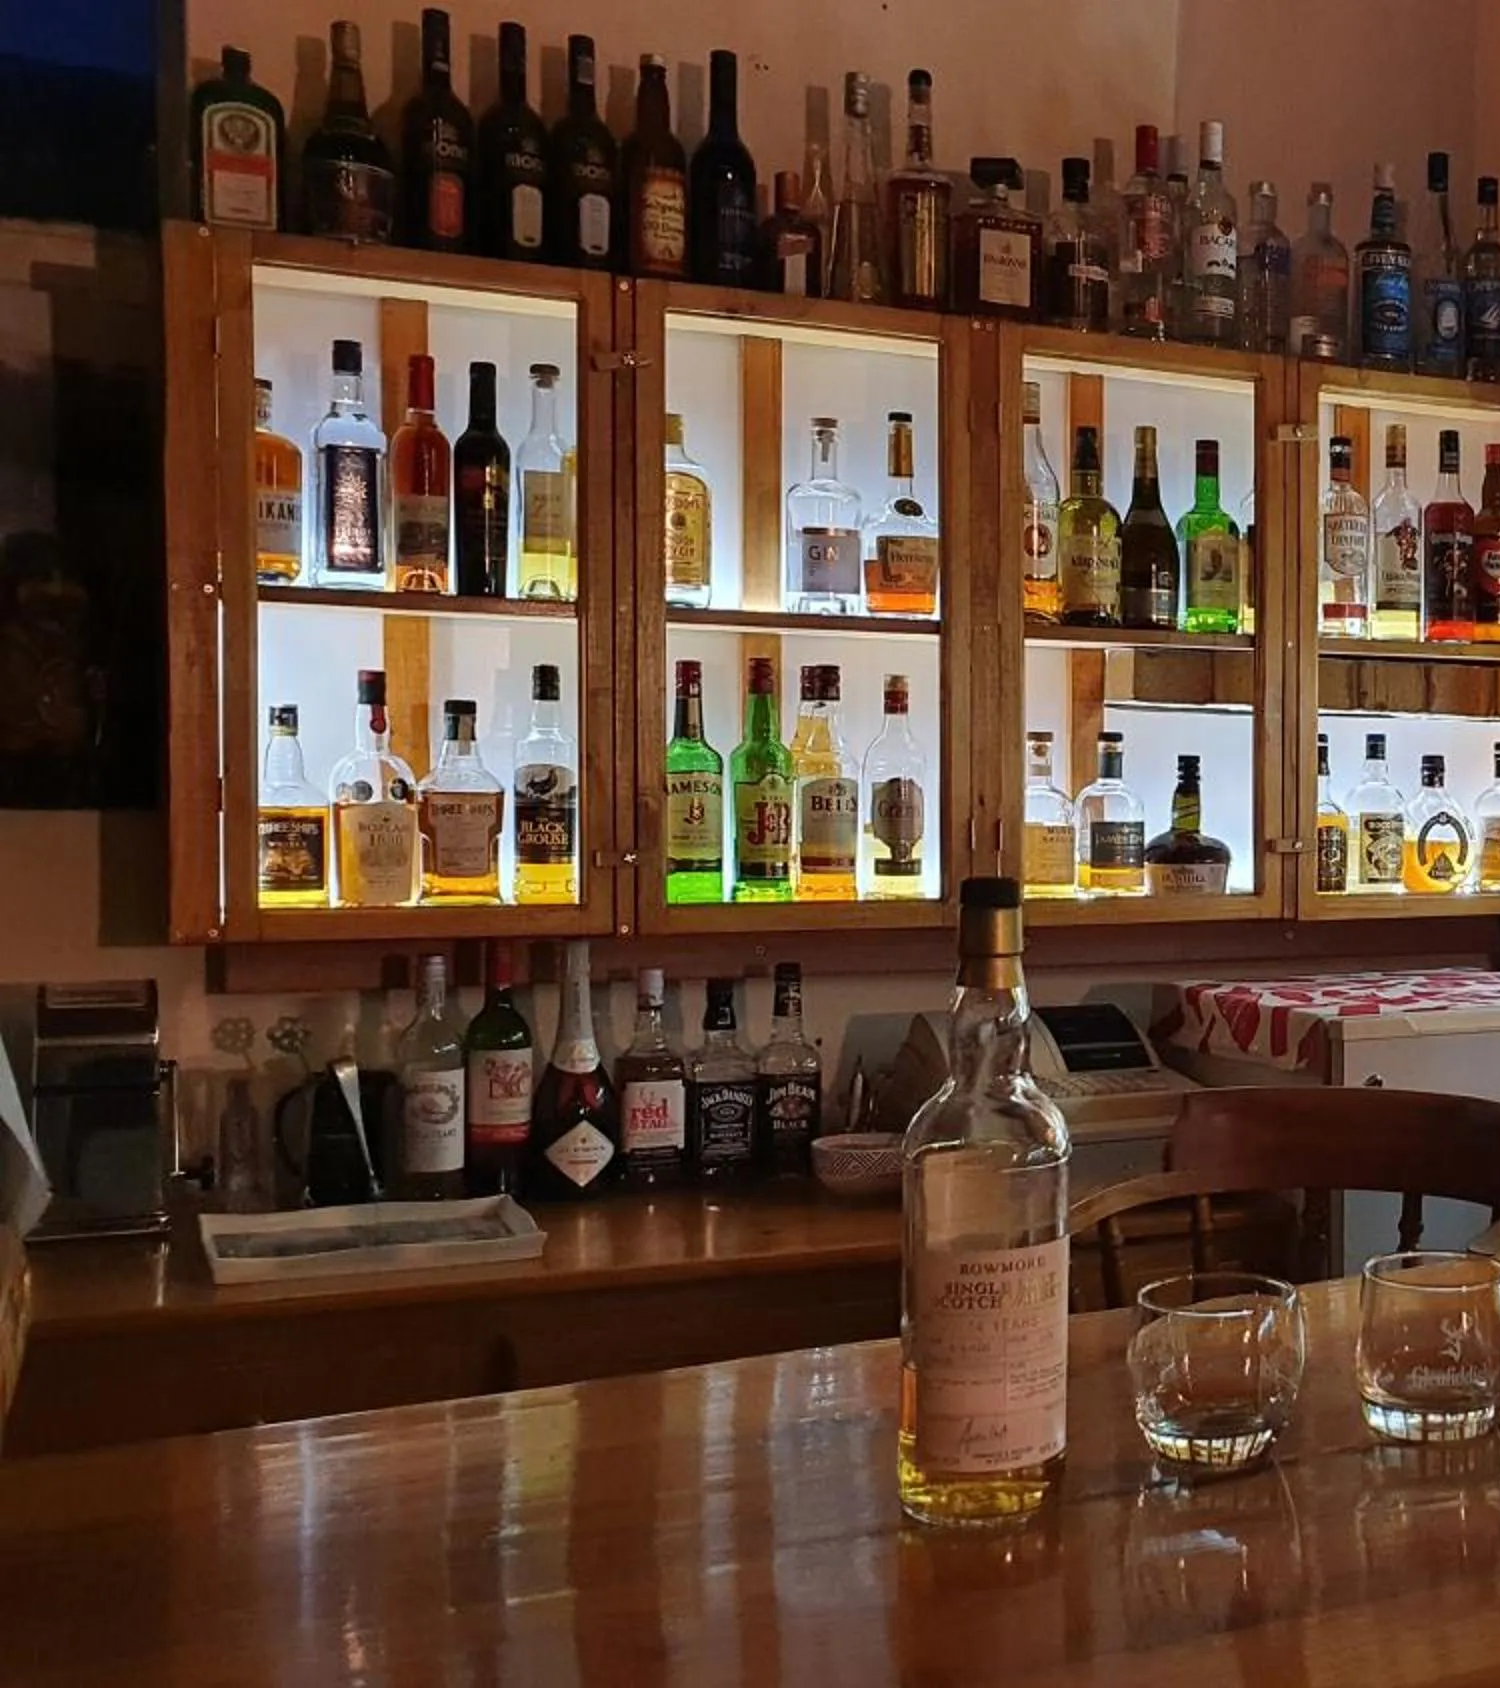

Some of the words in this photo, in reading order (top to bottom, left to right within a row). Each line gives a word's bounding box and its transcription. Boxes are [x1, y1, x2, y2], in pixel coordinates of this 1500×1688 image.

[808, 545, 840, 561] GIN
[520, 820, 567, 834] BLACK
[959, 1256, 1047, 1275] BOWMORE
